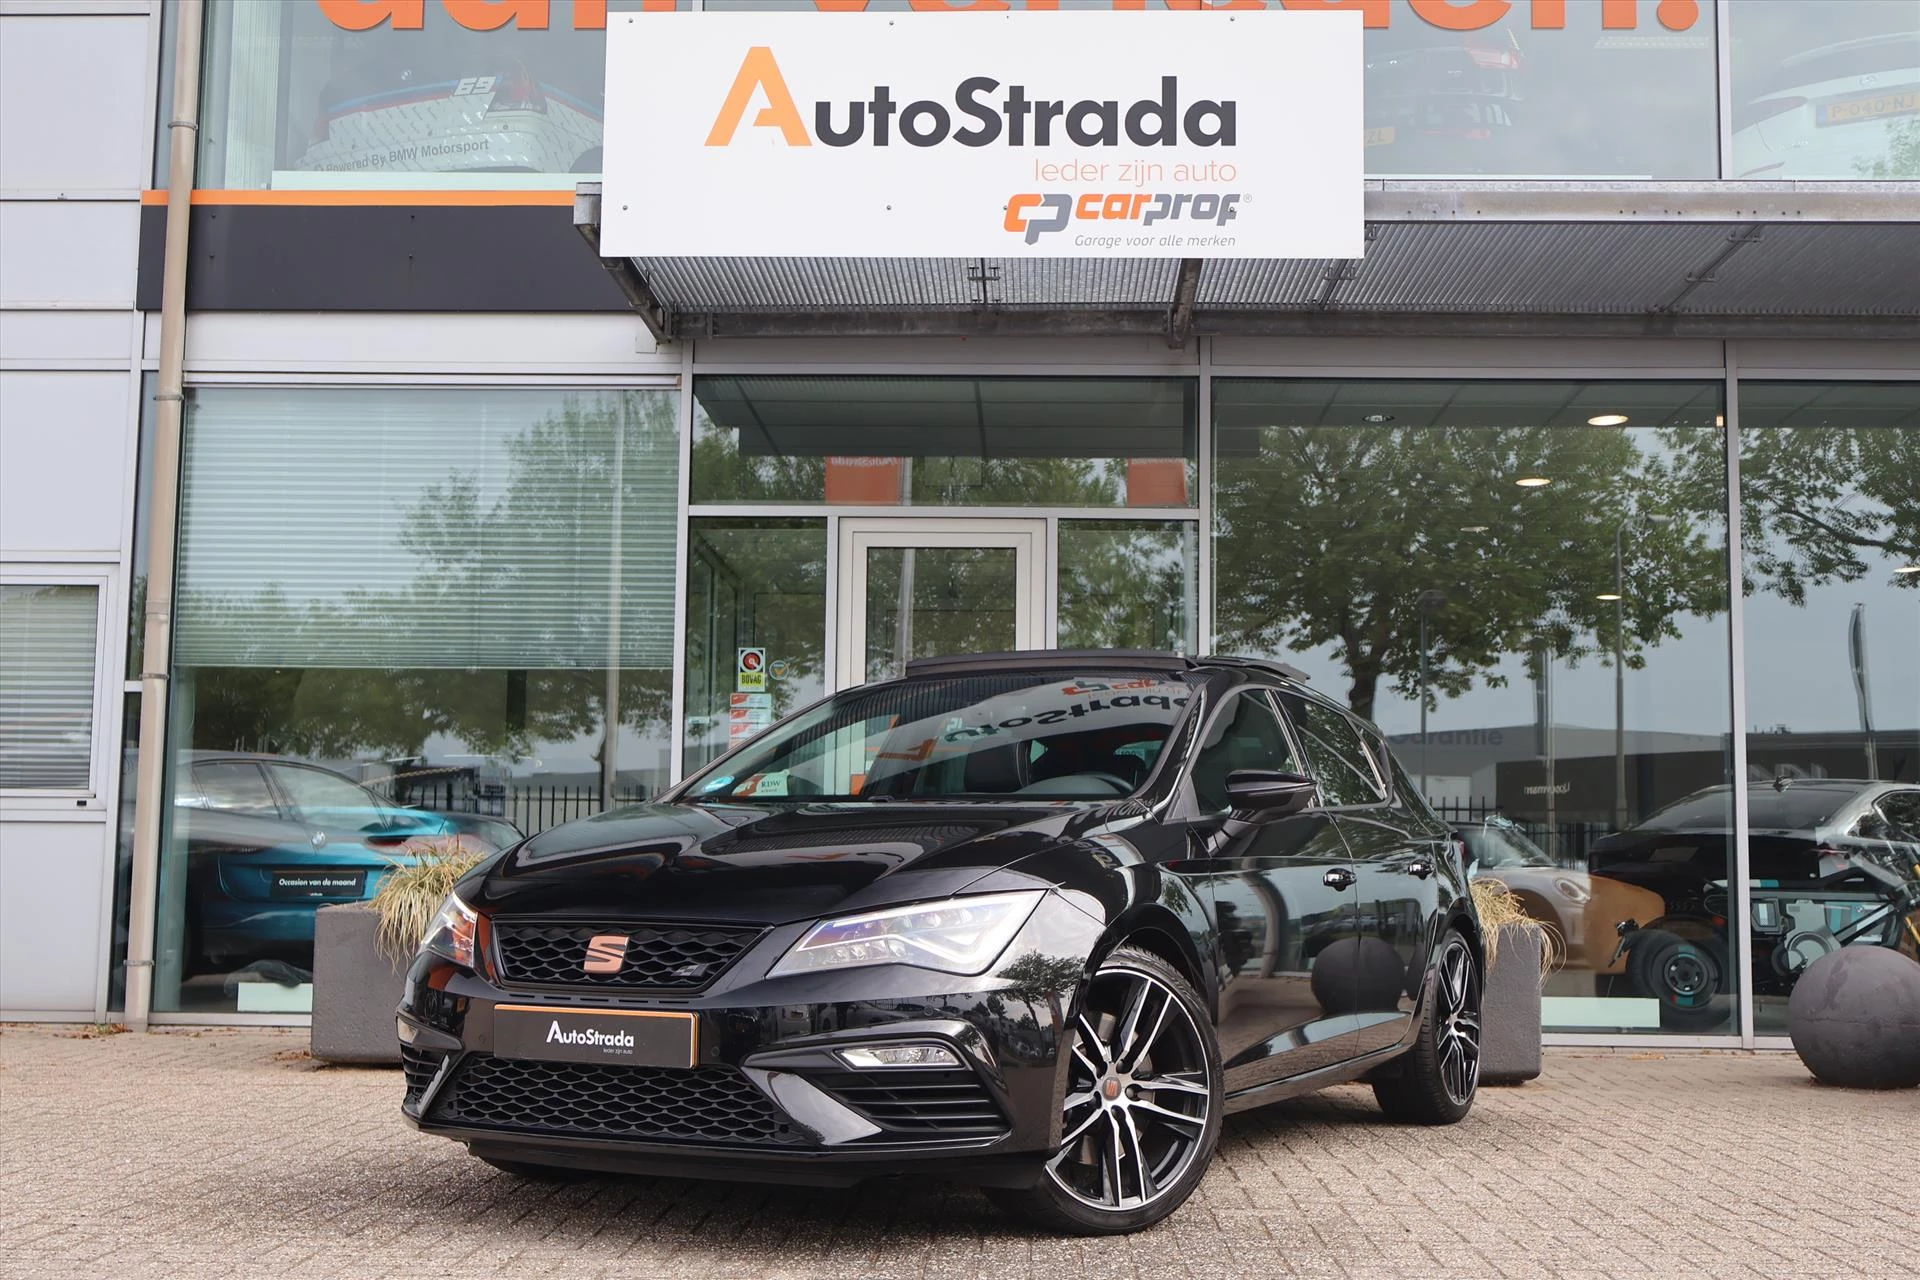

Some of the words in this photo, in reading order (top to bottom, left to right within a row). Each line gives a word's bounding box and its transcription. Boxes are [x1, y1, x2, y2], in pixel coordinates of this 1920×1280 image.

[453, 76, 497, 97] 69
[705, 46, 1236, 147] AutoStrada
[326, 155, 369, 172] Powered
[371, 154, 386, 169] By
[389, 147, 418, 162] BMW
[421, 138, 490, 158] Motorsport
[1034, 158, 1110, 183] Ieder
[1117, 158, 1163, 188] zijn
[1173, 159, 1238, 183] auto
[1074, 234, 1122, 249] Garage
[1126, 236, 1156, 247] voor
[1158, 234, 1183, 247] alle
[1187, 234, 1236, 247] merken
[741, 674, 762, 685] BOVAG
[761, 780, 781, 788] RDW
[278, 877, 308, 887] Occasion
[309, 878, 322, 886] van
[322, 877, 331, 886] de
[332, 877, 357, 886] maand
[546, 1020, 635, 1048] AutoStrada
